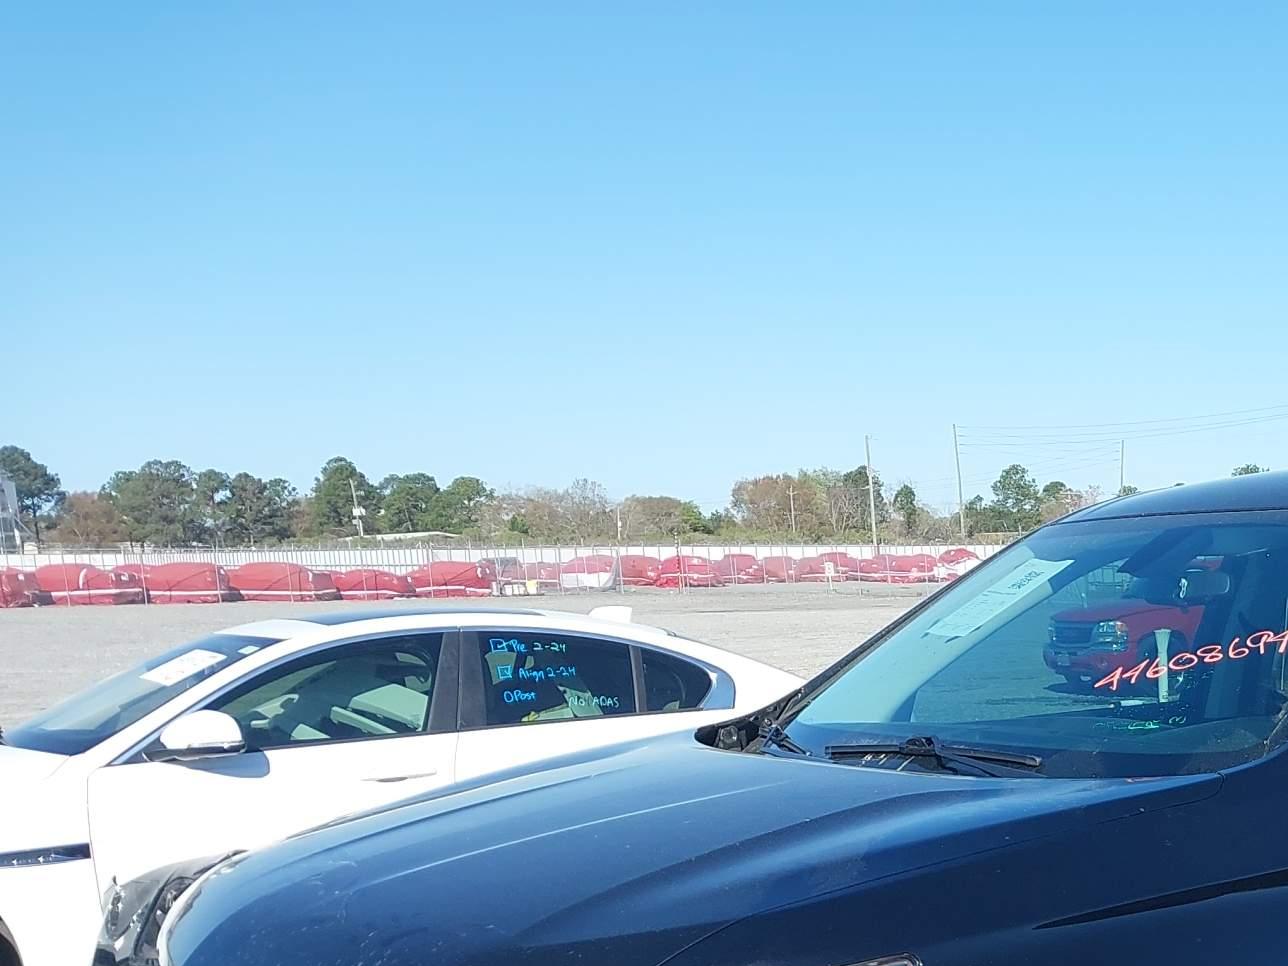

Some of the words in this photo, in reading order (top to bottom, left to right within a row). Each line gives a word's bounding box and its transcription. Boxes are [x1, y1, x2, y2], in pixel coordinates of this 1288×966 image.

[511, 639, 528, 653] Pre
[532, 642, 566, 653] 2-24
[518, 667, 545, 682] Align
[547, 666, 577, 678] 2-24
[568, 696, 585, 707] No
[592, 696, 620, 708] ADAS
